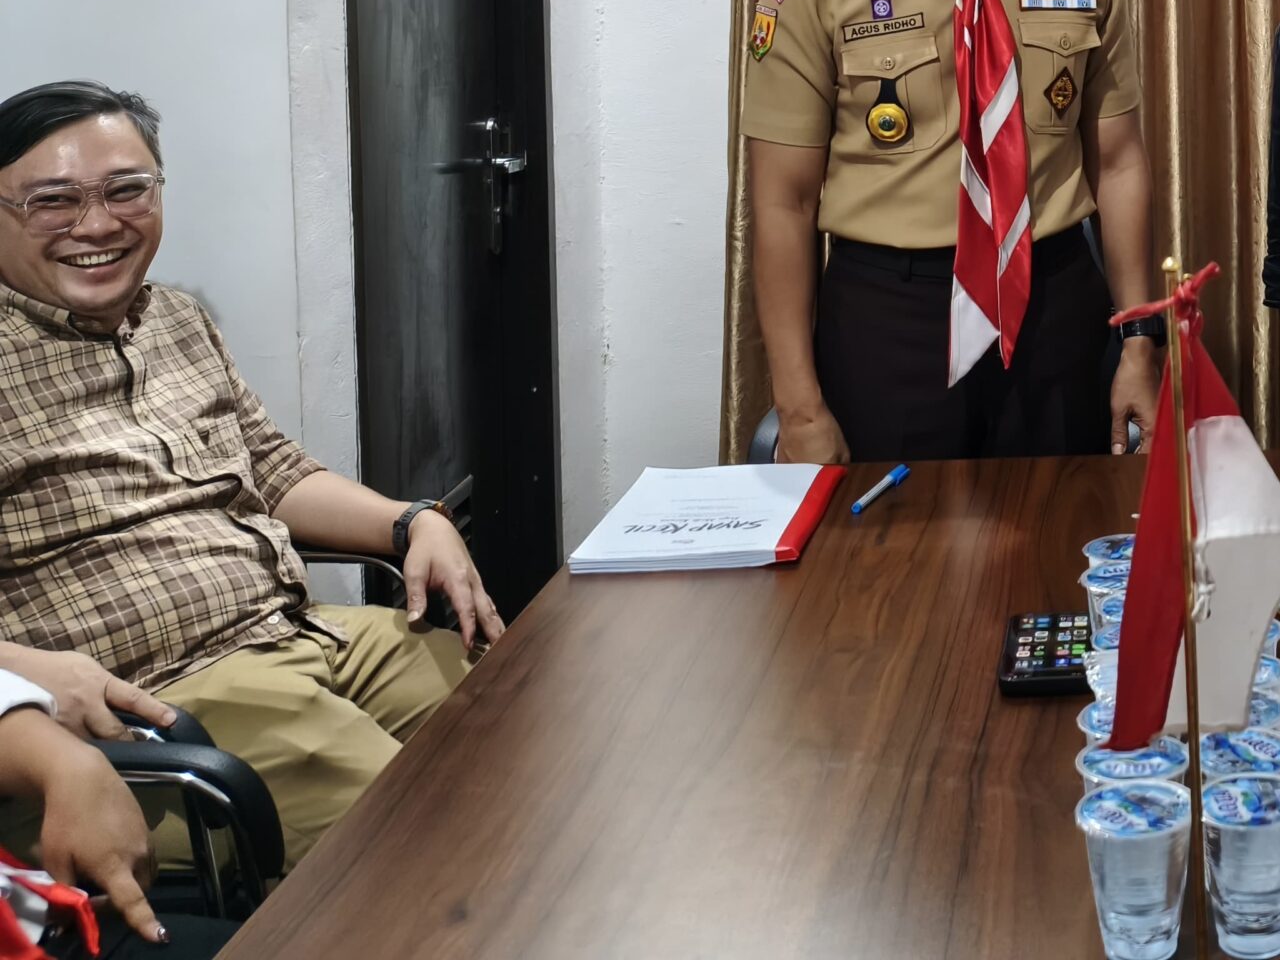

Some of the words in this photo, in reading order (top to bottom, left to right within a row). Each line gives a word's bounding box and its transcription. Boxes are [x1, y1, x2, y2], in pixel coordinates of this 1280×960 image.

[851, 25, 880, 38] AGUS
[883, 18, 916, 31] RIDHO
[624, 522, 688, 534] KECIL
[689, 518, 768, 531] SAYAP
